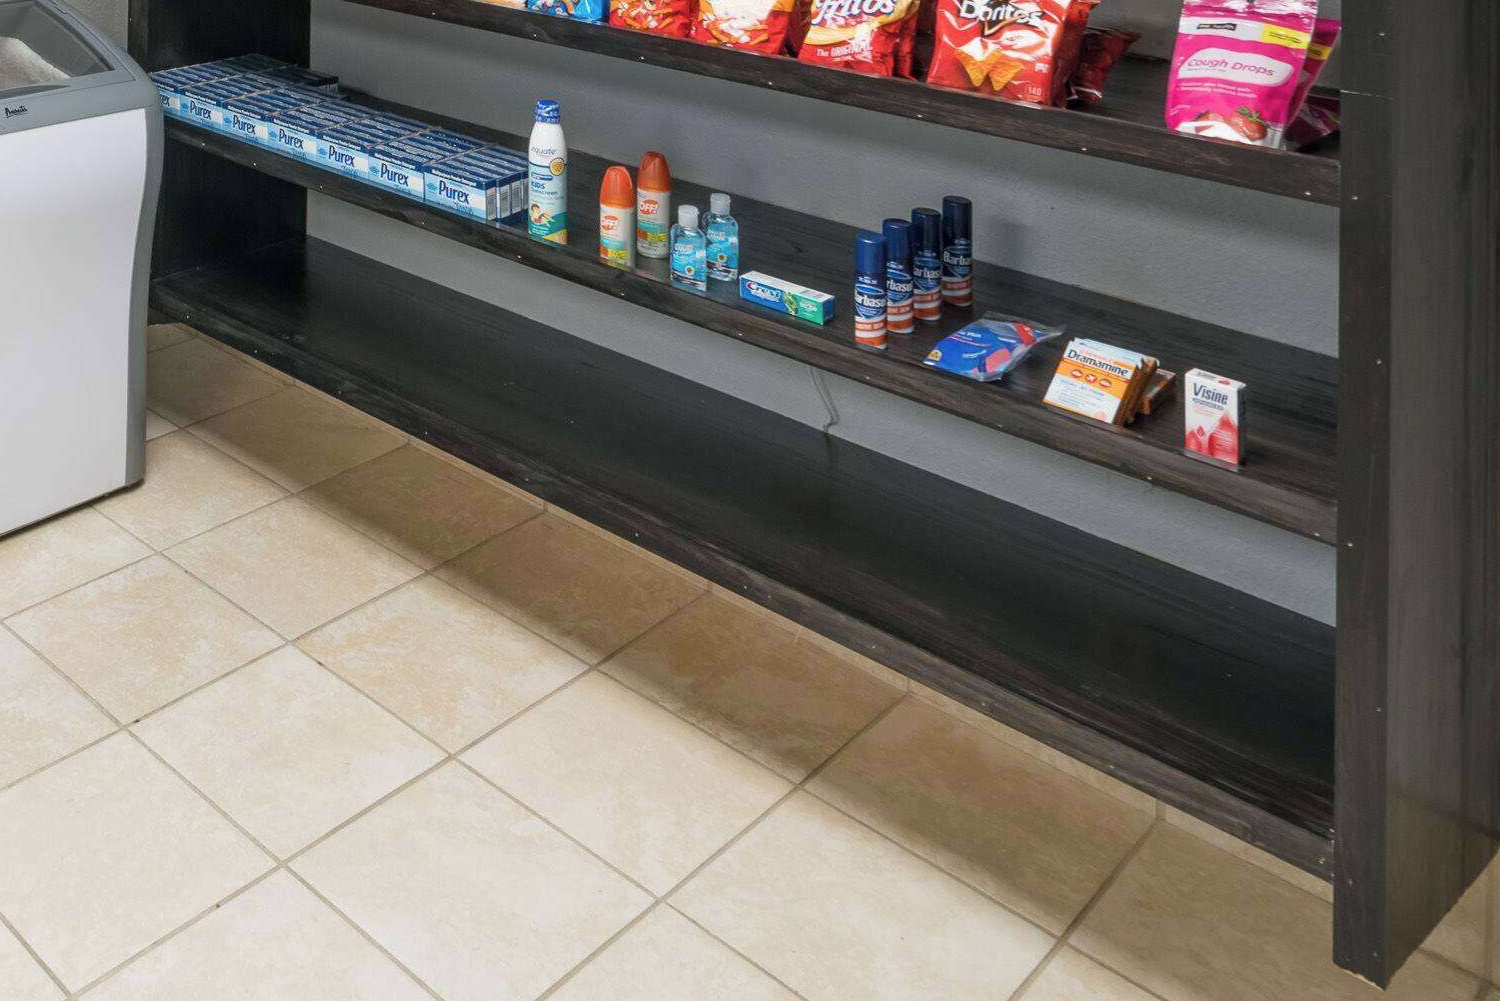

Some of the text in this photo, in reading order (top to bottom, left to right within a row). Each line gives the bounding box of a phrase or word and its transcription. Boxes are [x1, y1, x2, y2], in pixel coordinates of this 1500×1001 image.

[959, 0, 1046, 24] Doritos
[1187, 58, 1276, 77] Cough Drops
[189, 100, 212, 120] Purex
[232, 114, 257, 135] Purex
[278, 128, 304, 150] Purex
[328, 145, 355, 168] Purex
[380, 162, 409, 187] Purex
[438, 179, 470, 205] Purex
[943, 250, 972, 266] Barba
[1067, 348, 1129, 376] Dramamine
[1192, 382, 1229, 405] Visine
